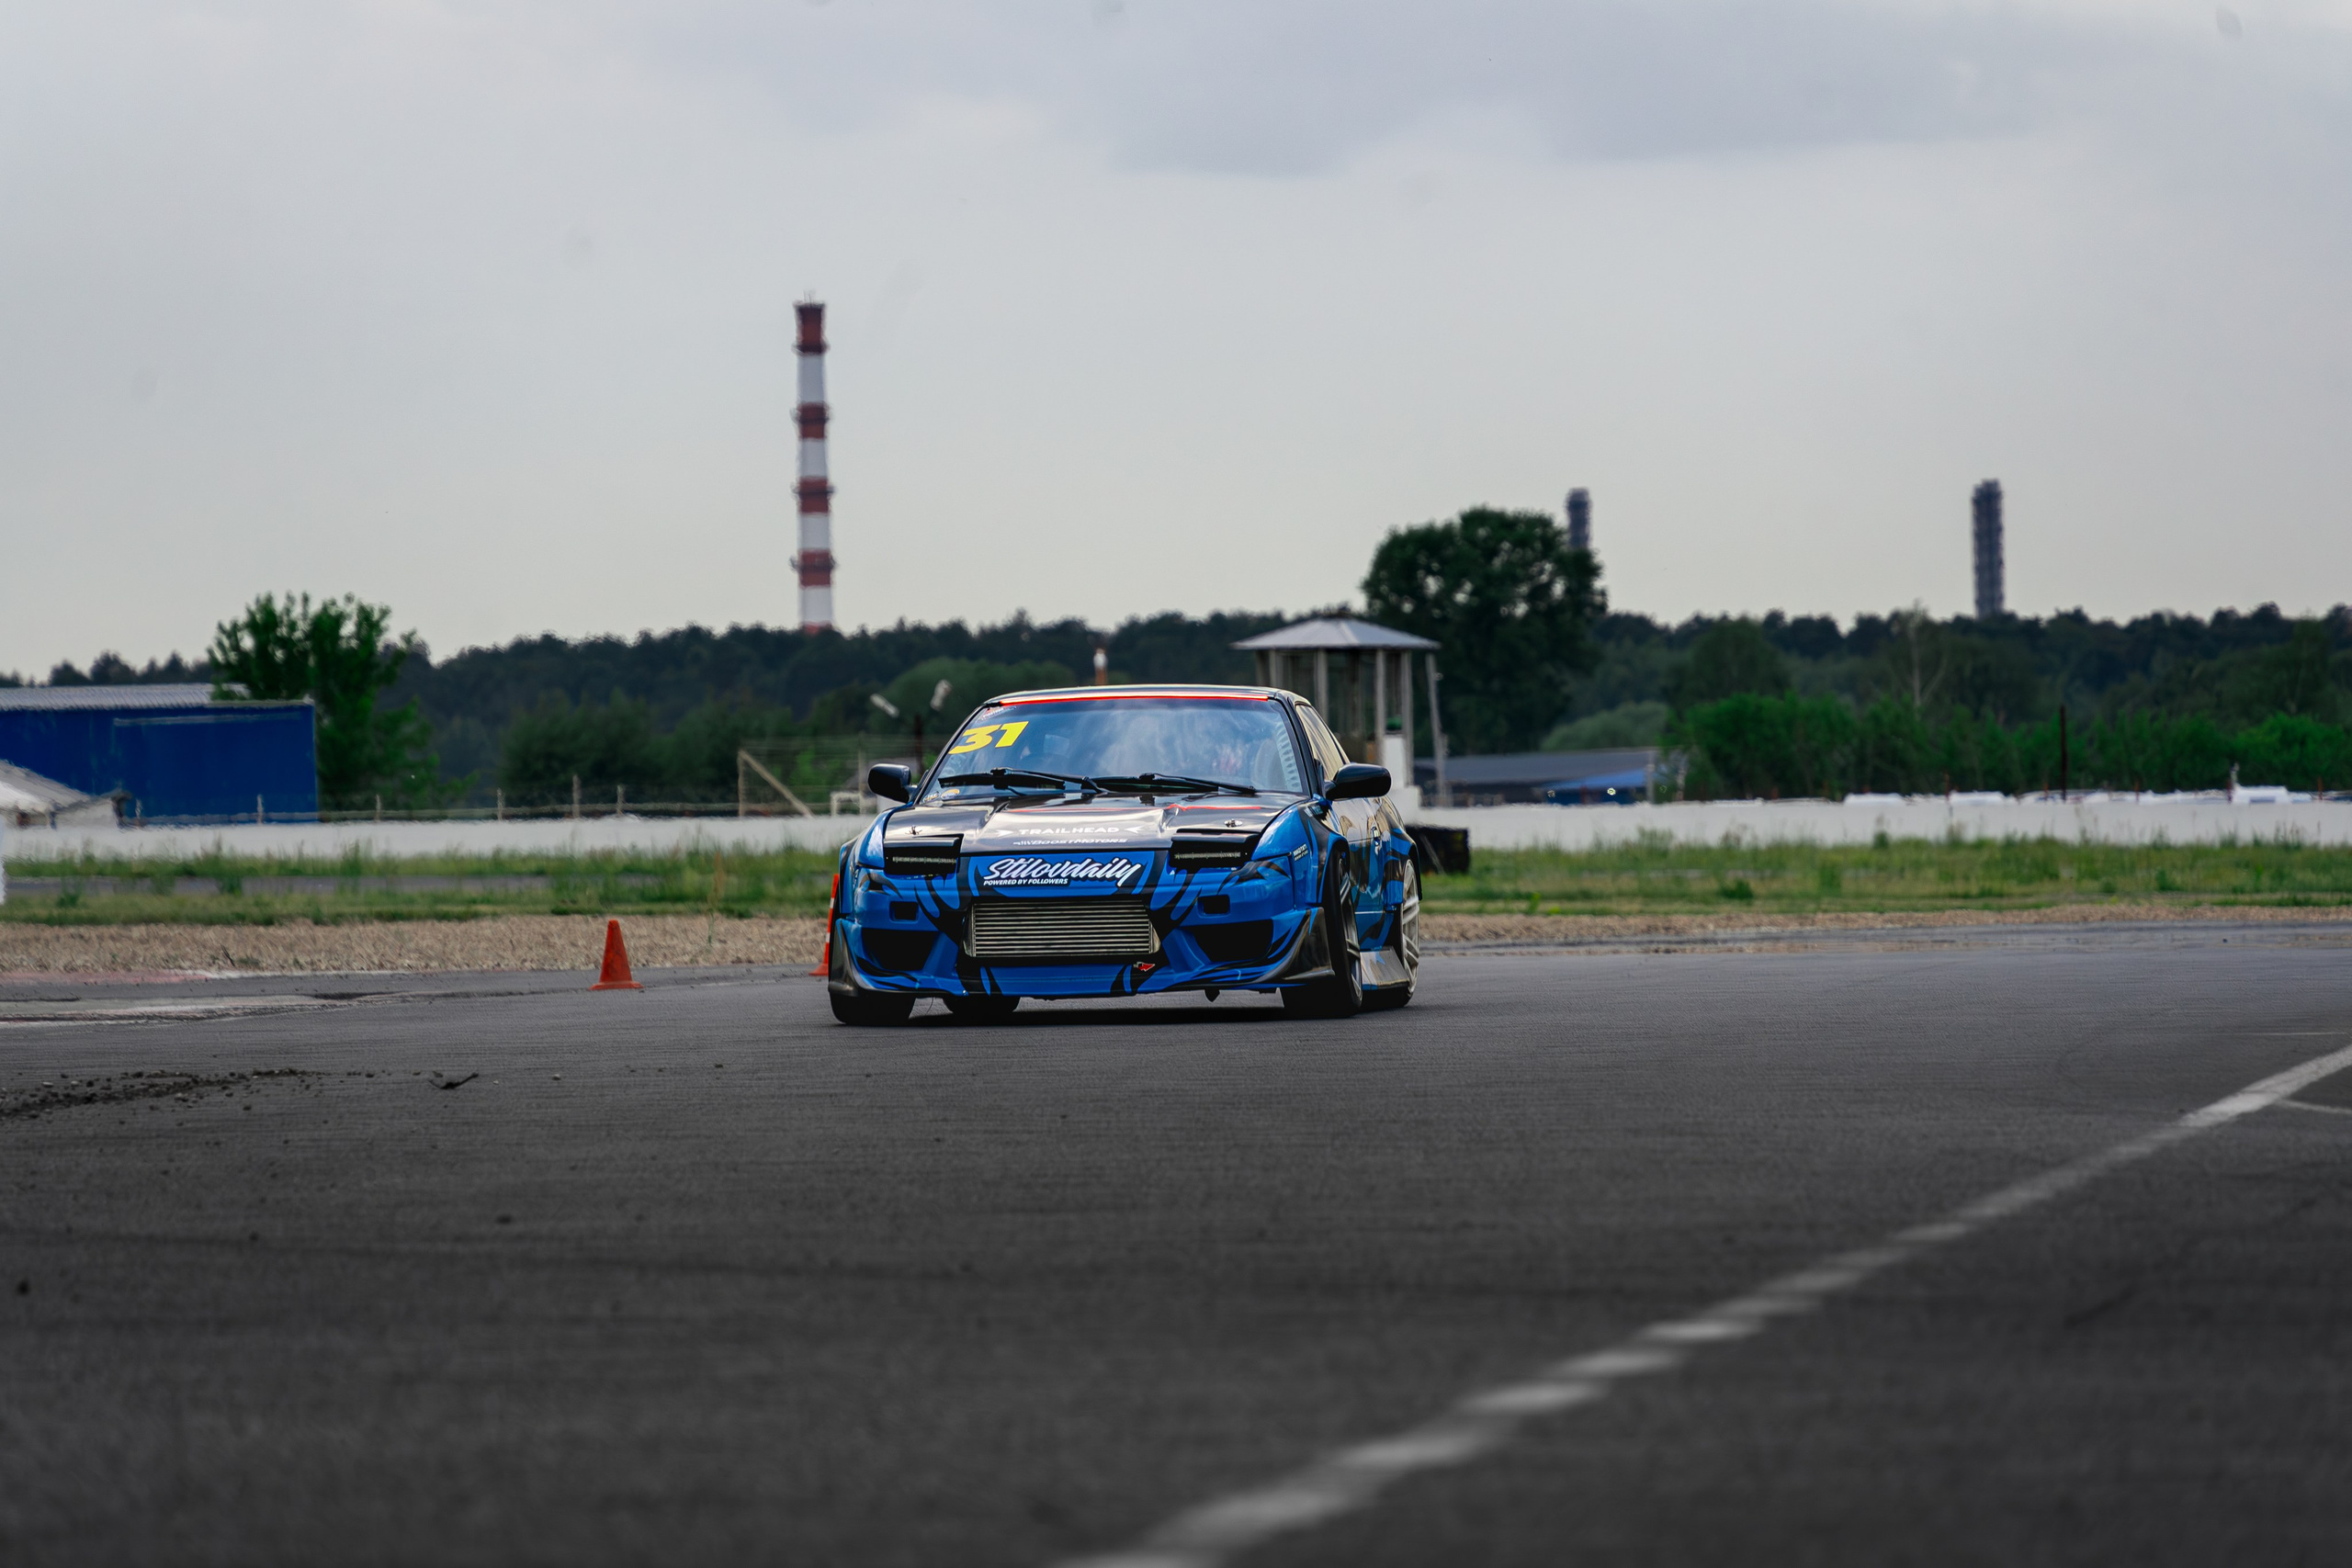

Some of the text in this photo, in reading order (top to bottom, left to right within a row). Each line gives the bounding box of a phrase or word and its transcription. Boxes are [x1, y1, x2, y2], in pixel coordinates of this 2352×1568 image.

[948, 721, 1029, 754] 31
[1019, 827, 1120, 835] TRAILHEAD
[983, 857, 1141, 887] Stilovdaily
